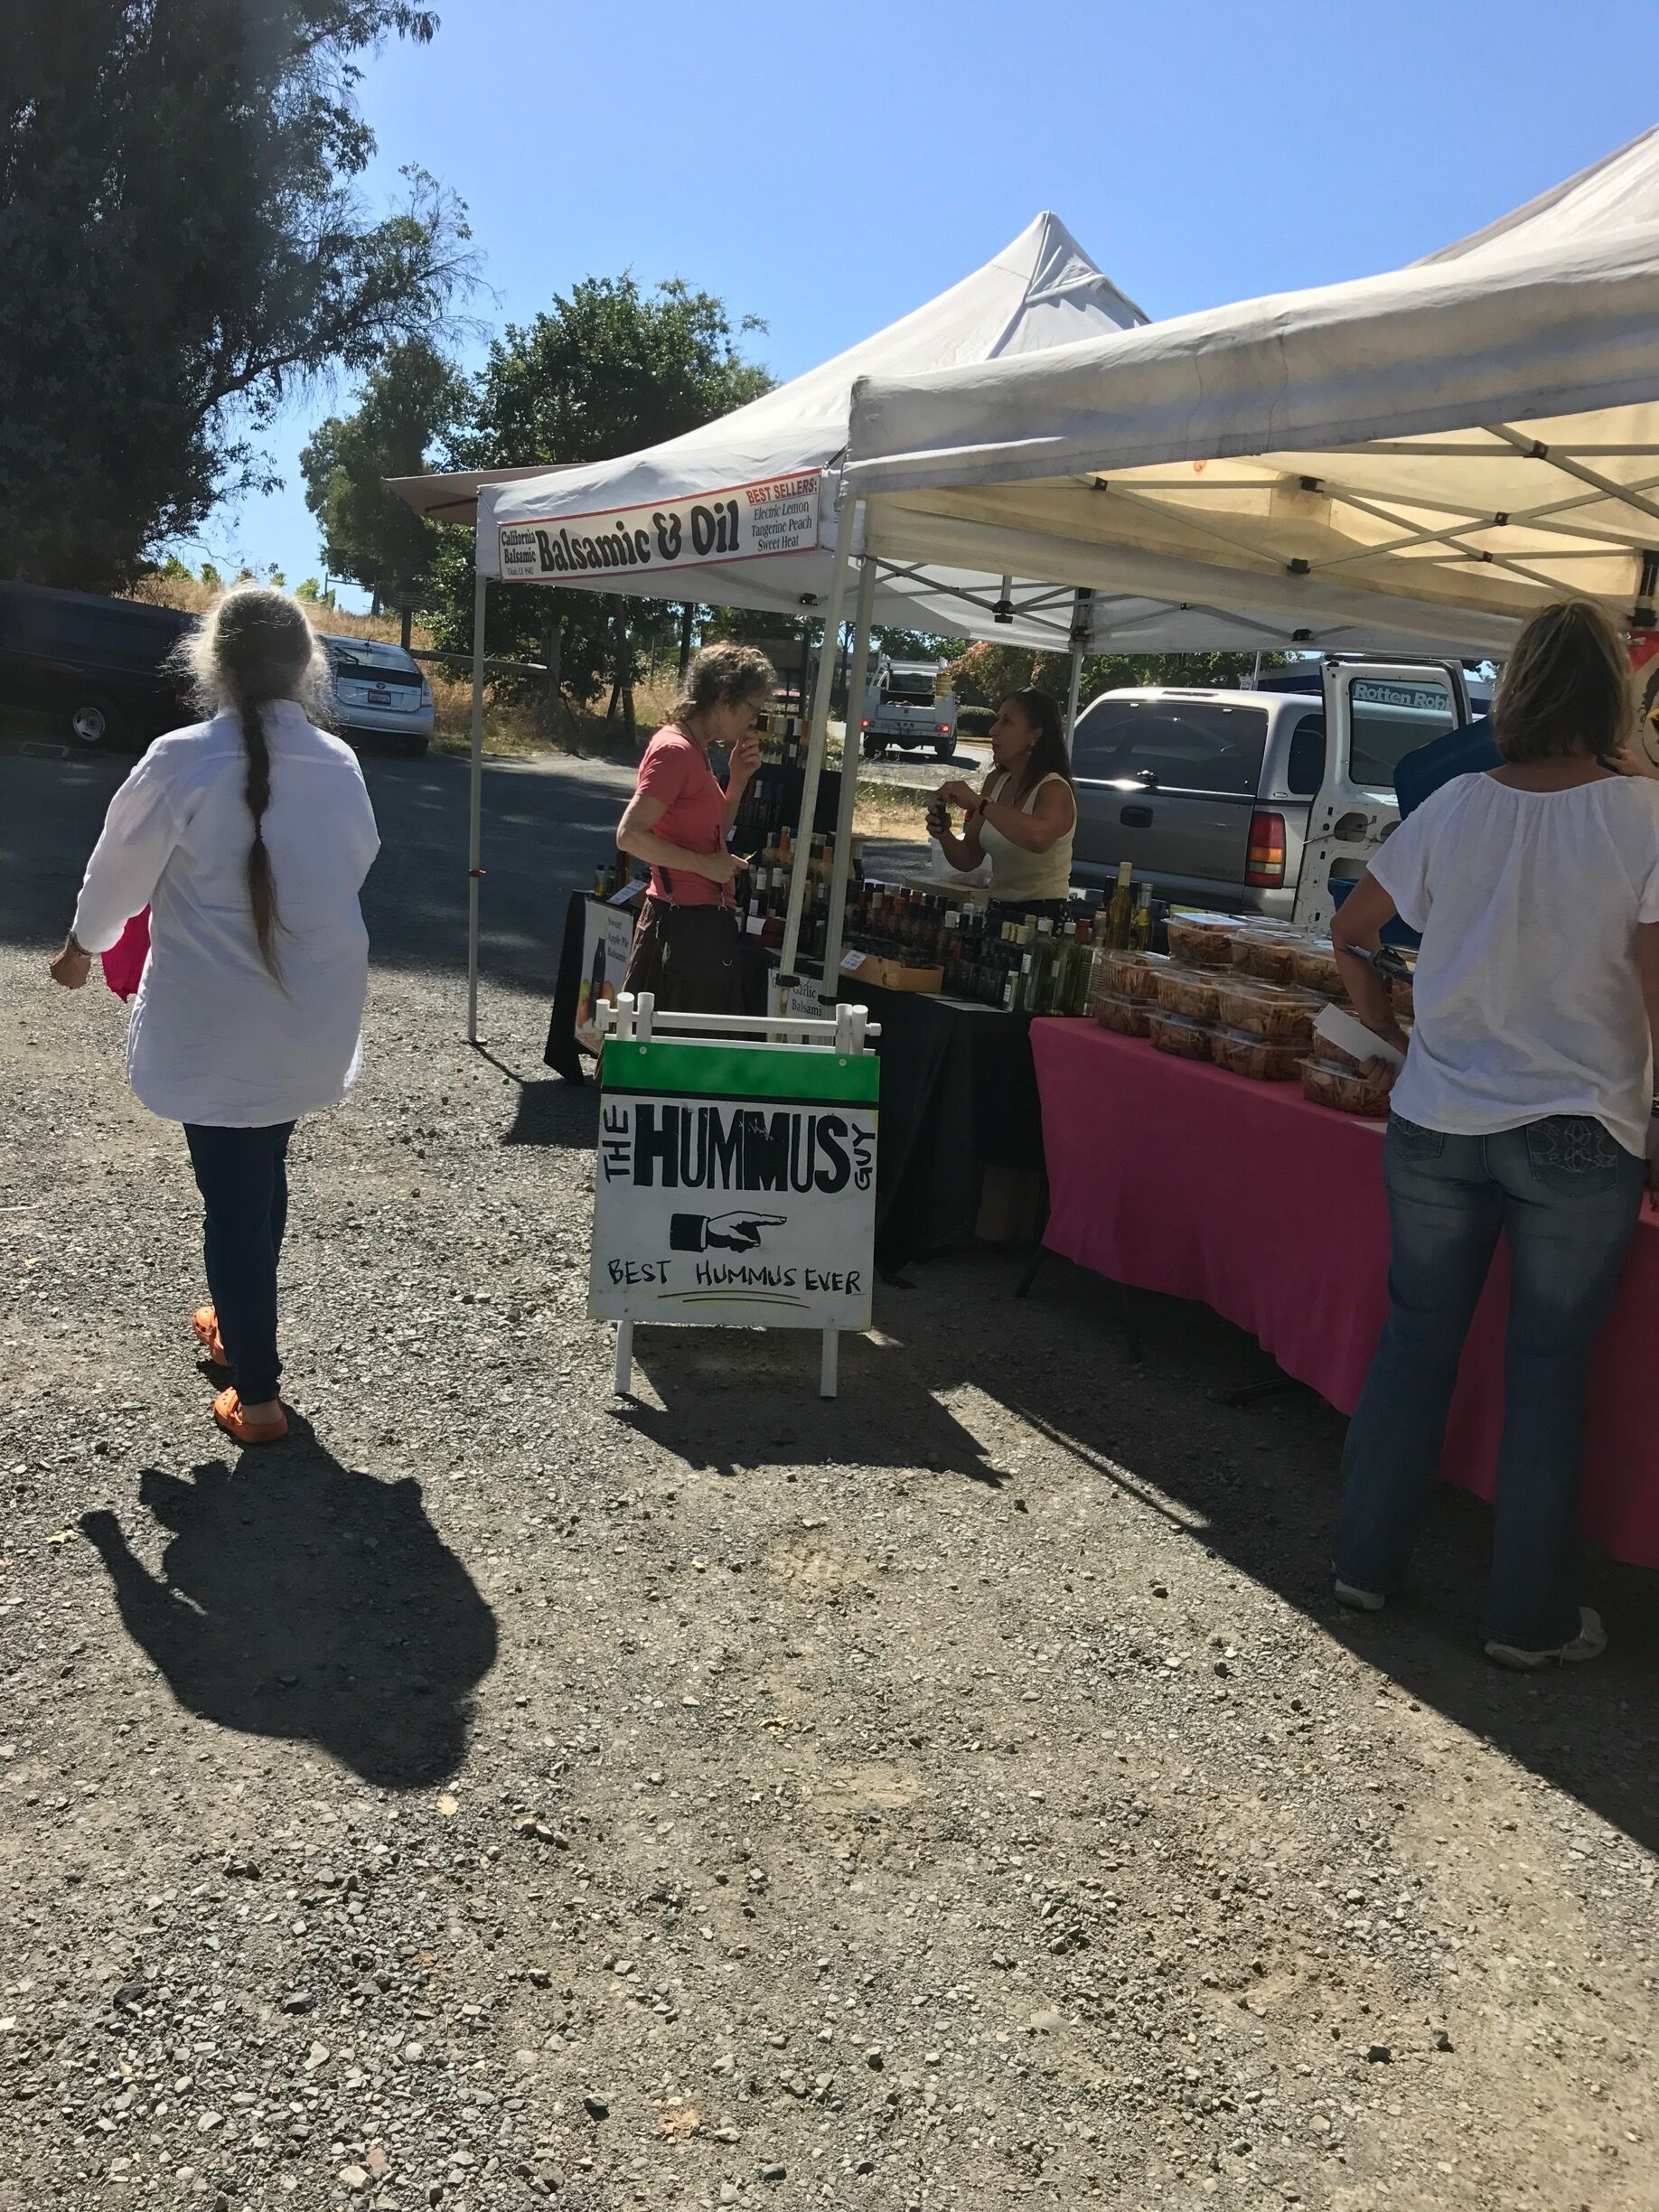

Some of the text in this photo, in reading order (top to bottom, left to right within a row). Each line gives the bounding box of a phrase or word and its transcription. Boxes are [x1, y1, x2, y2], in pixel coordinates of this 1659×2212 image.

[745, 477, 818, 503] BEST SELLERS:
[754, 501, 810, 520] Electric Lemon
[501, 529, 536, 546] California
[536, 499, 739, 571] Balsamic & Oil
[751, 515, 812, 539] Tangerine Peach
[757, 534, 799, 552] Sweet Heat
[504, 547, 536, 564] Balsamic
[1354, 683, 1411, 704] Rotten
[792, 983, 816, 998] Garlic
[792, 998, 822, 1017] Balsami
[602, 1104, 632, 1184] THE
[633, 1103, 851, 1194] HUMMUS
[851, 1122, 876, 1191] GUY
[607, 1259, 862, 1295] BEST HUMMUS EVER
